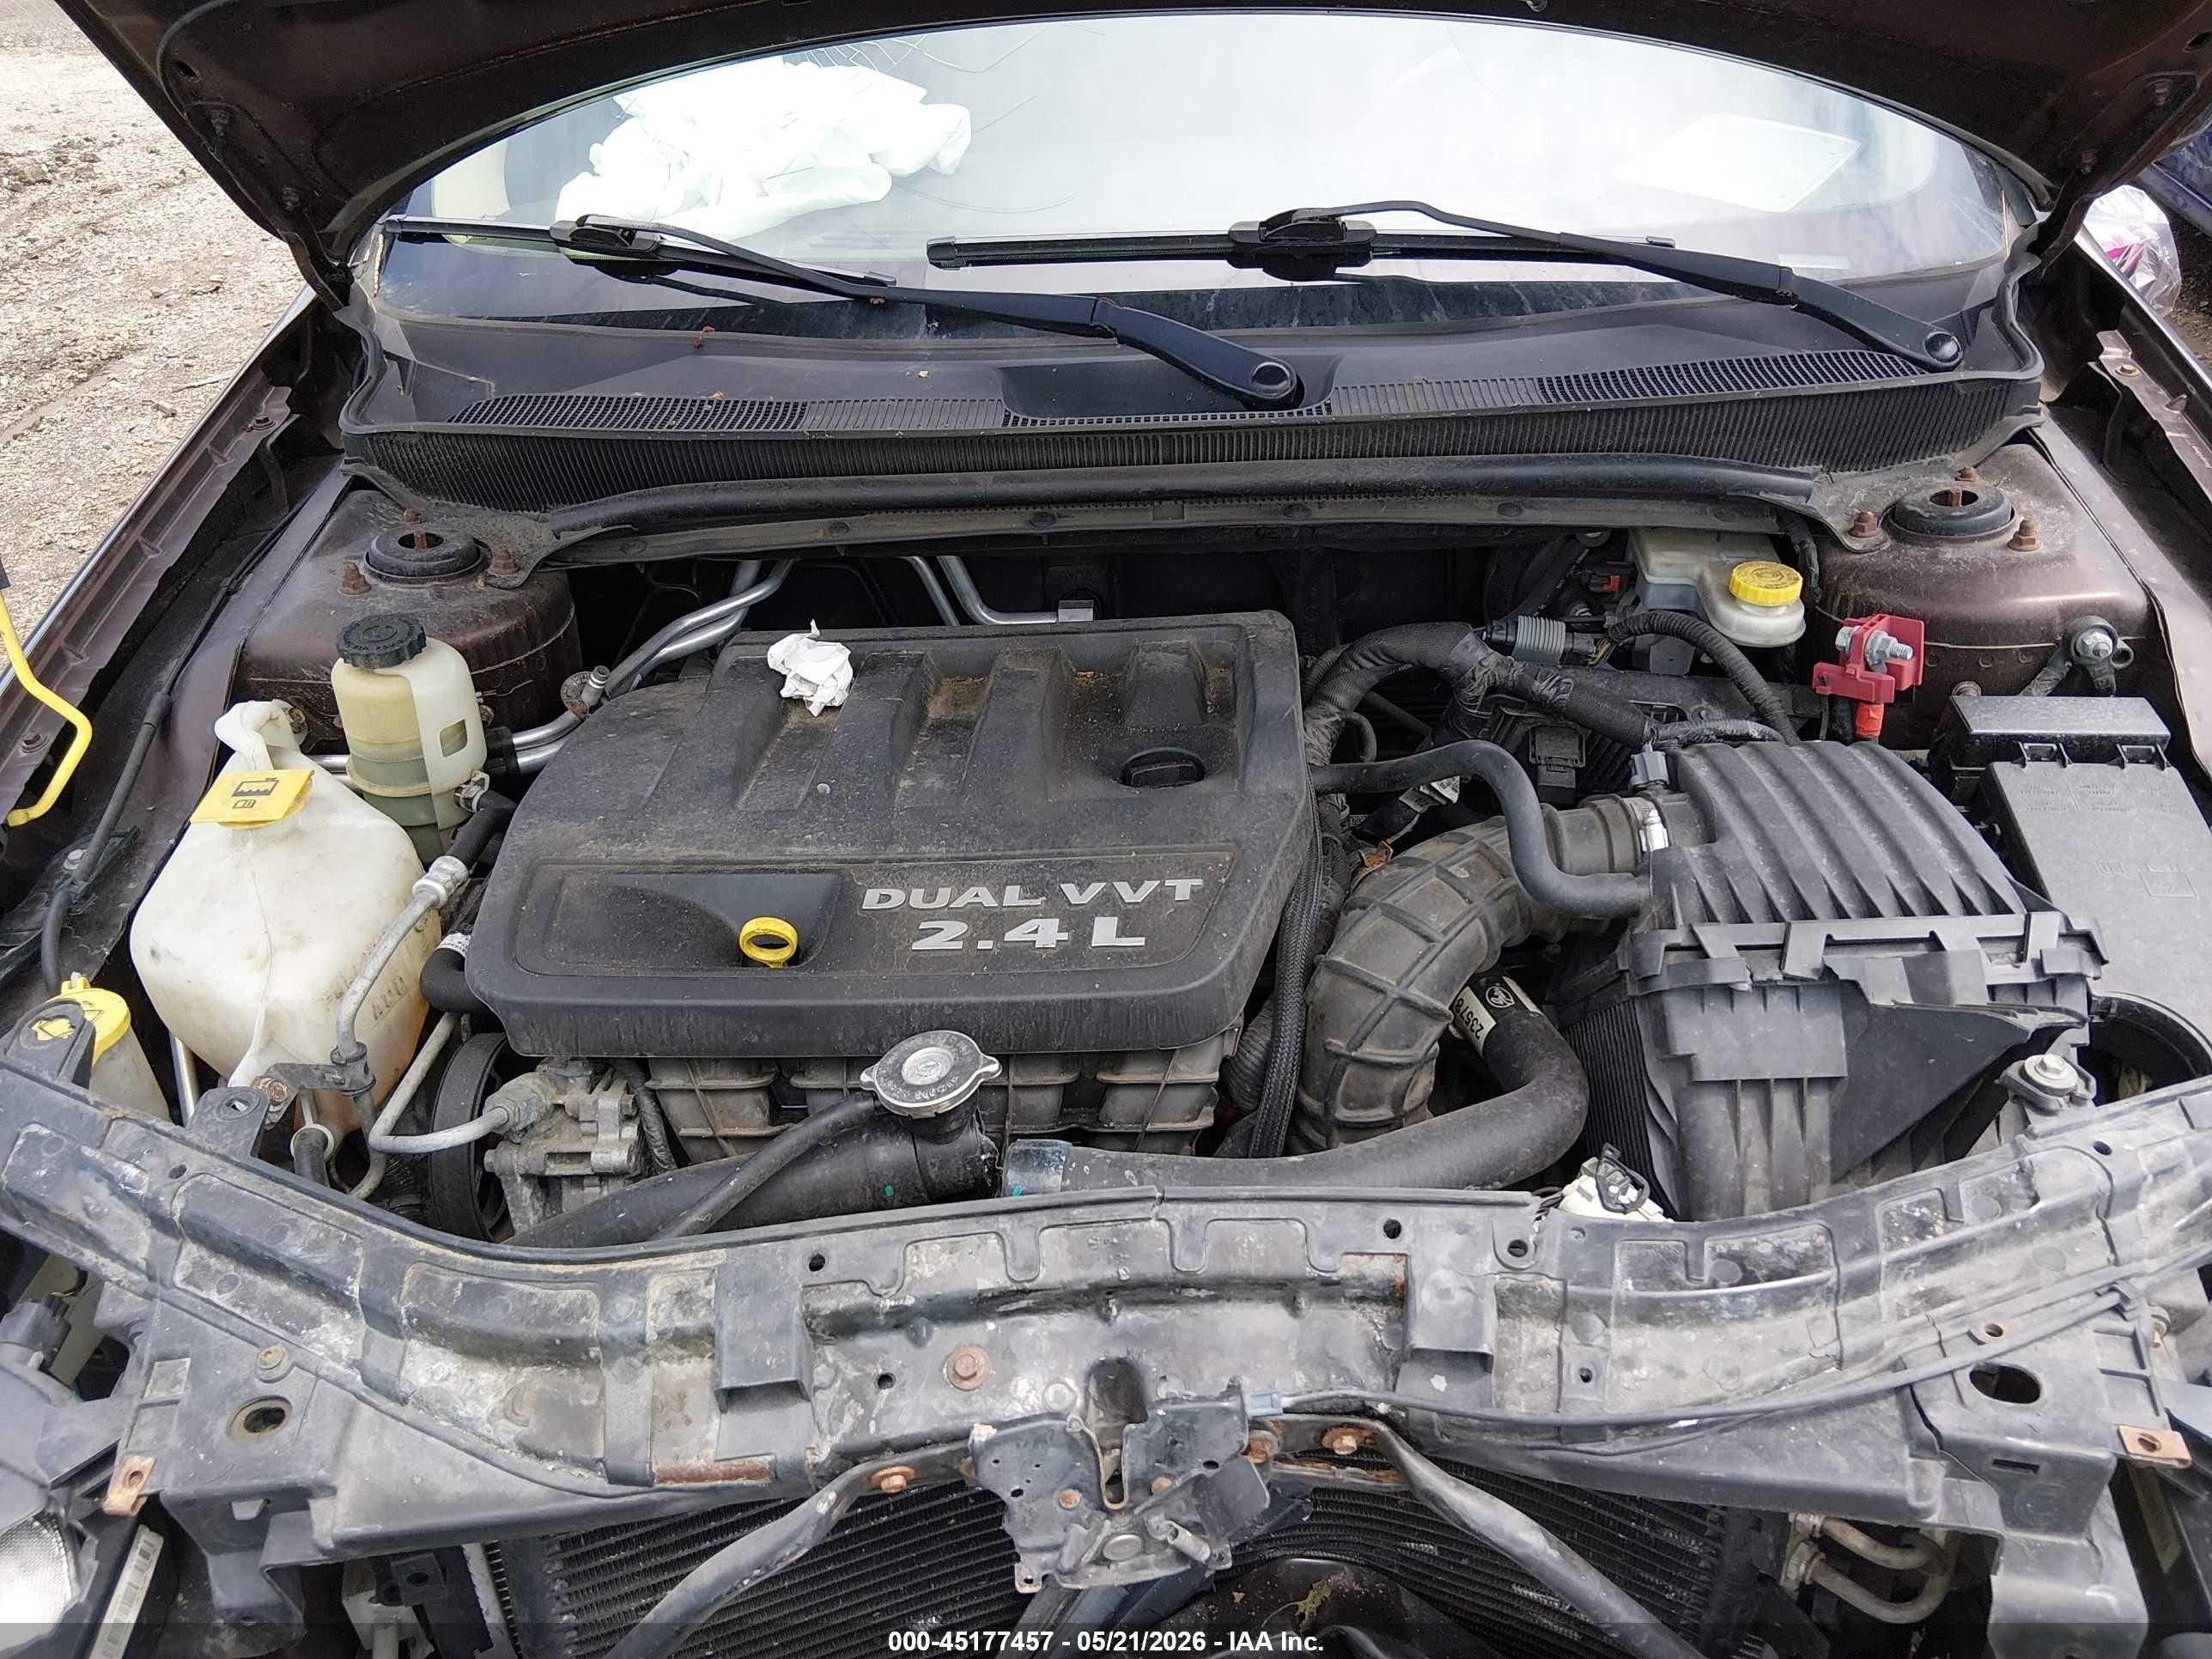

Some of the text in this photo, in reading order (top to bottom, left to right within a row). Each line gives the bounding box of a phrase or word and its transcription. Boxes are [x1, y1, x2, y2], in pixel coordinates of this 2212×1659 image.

[862, 879, 1203, 909] DUAL VVT
[1455, 998, 1485, 1040] 23578
